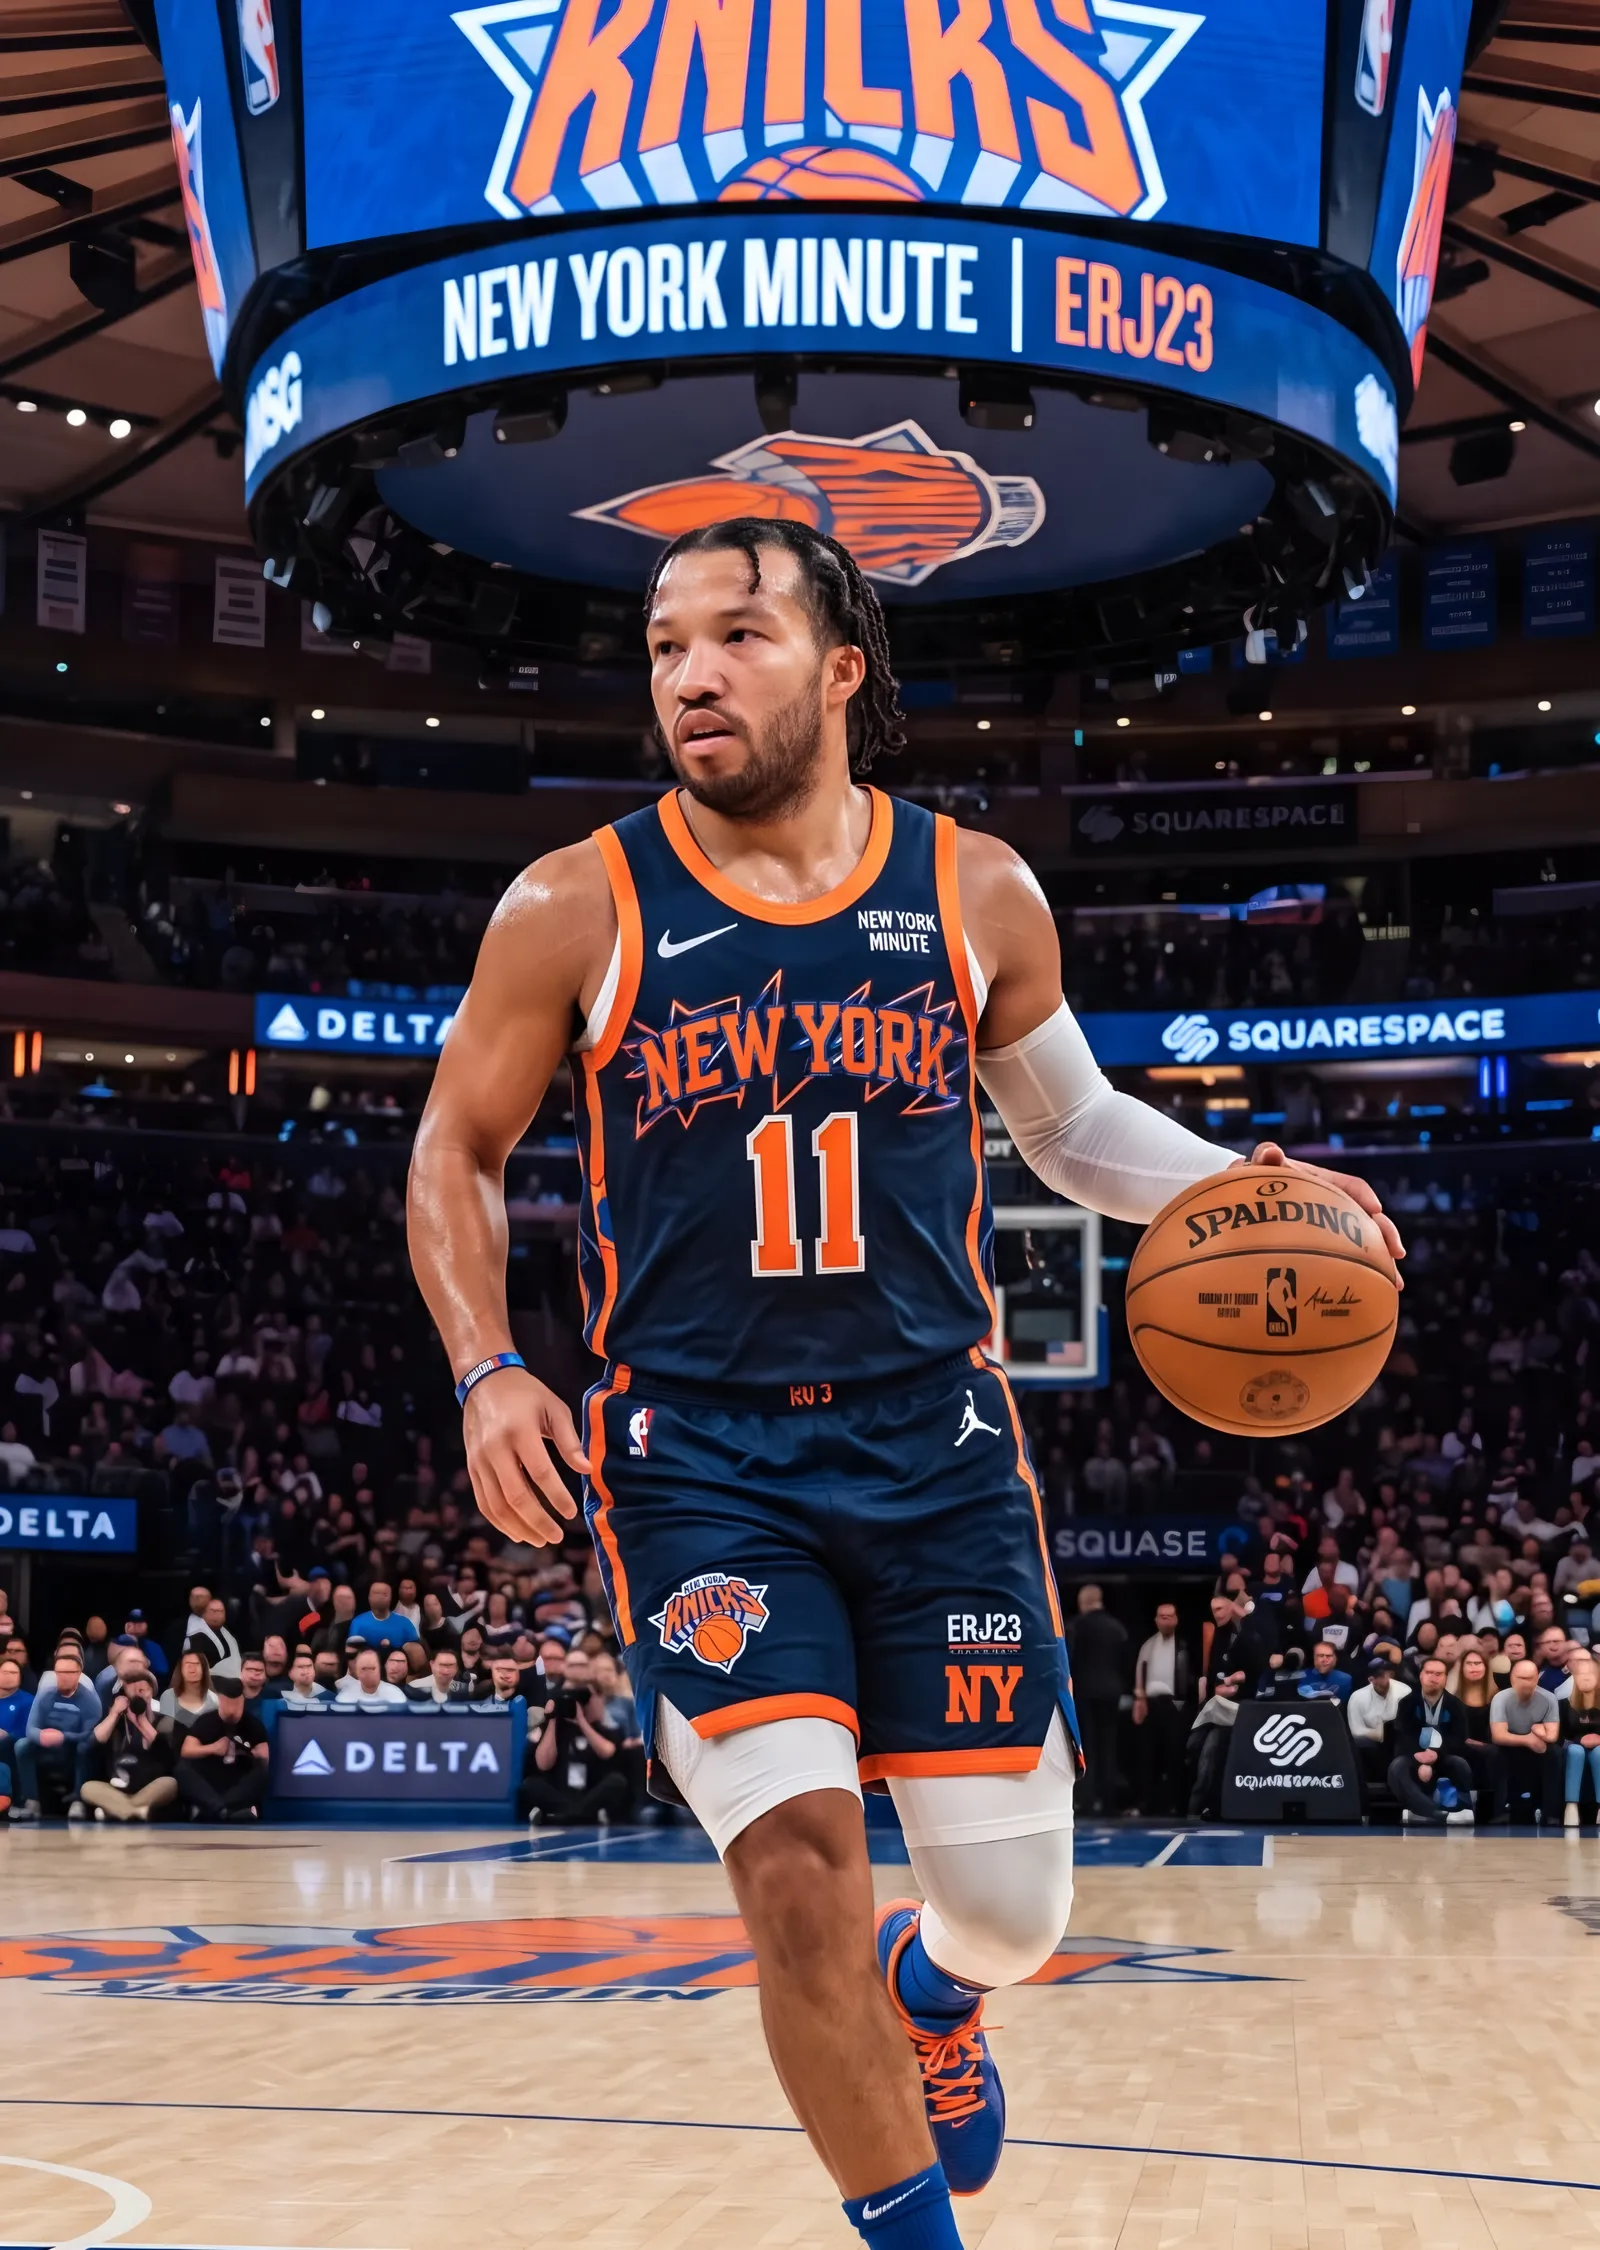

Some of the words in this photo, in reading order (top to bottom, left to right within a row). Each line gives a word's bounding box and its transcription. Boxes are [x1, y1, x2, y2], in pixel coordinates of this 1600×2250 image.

[443, 257, 558, 366] NEW
[568, 240, 728, 341] YORK
[743, 237, 979, 334] MINUTE
[1055, 256, 1214, 373] ERJ23
[857, 910, 893, 930] NEW
[895, 911, 938, 933] YORK
[869, 932, 931, 954] MINUTE
[1227, 1007, 1506, 1052] SQUARESPACE
[637, 1003, 788, 1112] NEW
[791, 1000, 955, 1100] YORK
[746, 1111, 866, 1278] 11
[1184, 1200, 1364, 1249] SPALDING
[1054, 1528, 1207, 1559] SQUASE
[663, 1579, 767, 1644] KNICKS
[947, 1613, 1022, 1642] ERJ23
[944, 1665, 1024, 1723] NY
[345, 1741, 500, 1774] DELTA
